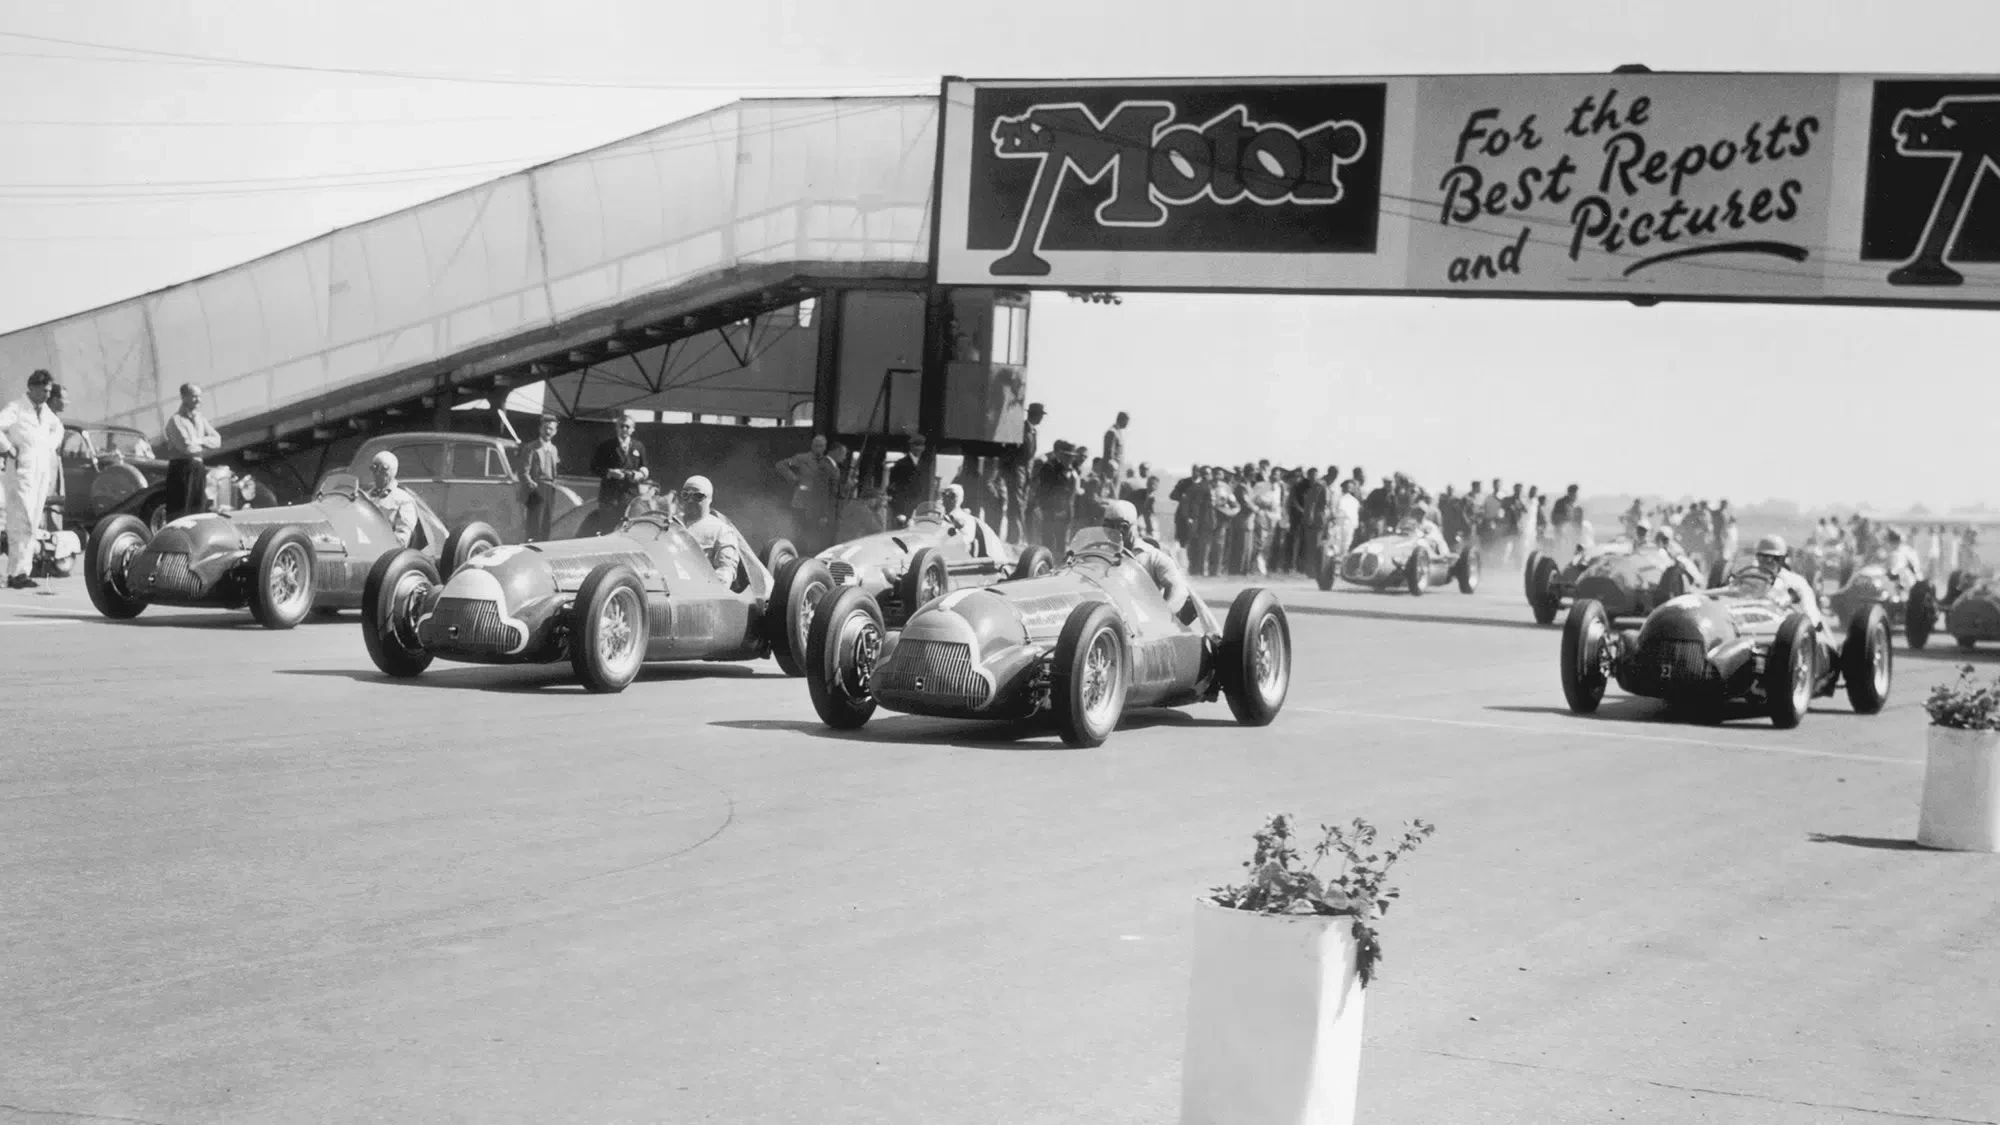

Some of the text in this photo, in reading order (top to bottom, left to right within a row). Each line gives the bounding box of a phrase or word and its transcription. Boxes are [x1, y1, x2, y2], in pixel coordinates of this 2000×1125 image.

[1439, 115, 1819, 225] Best Reports
[1454, 88, 1651, 164] For the
[990, 101, 1367, 275] Motor
[1447, 179, 1803, 283] and Pictures
